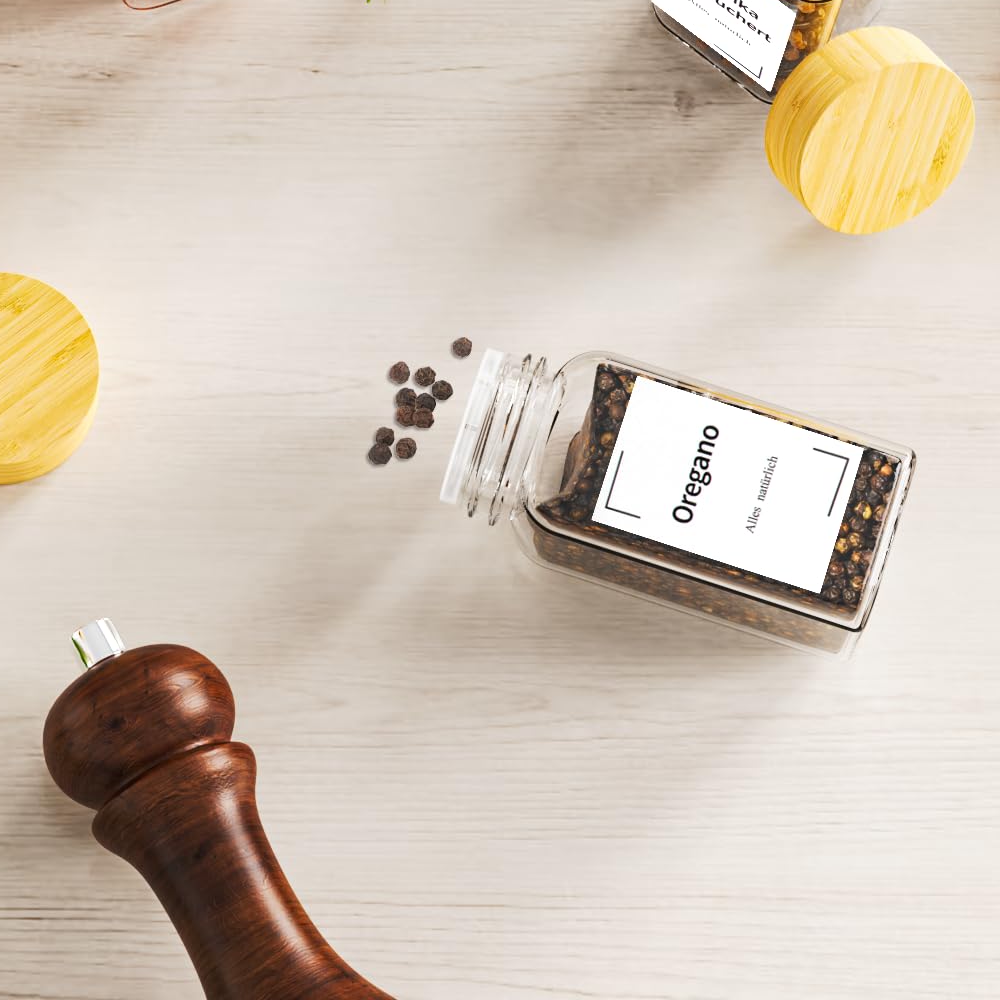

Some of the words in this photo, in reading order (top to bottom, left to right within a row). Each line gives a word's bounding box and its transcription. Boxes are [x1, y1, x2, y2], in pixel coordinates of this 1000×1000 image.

[672, 424, 720, 524] Oregano
[745, 506, 762, 534] Alles
[757, 455, 779, 502] natürlich
